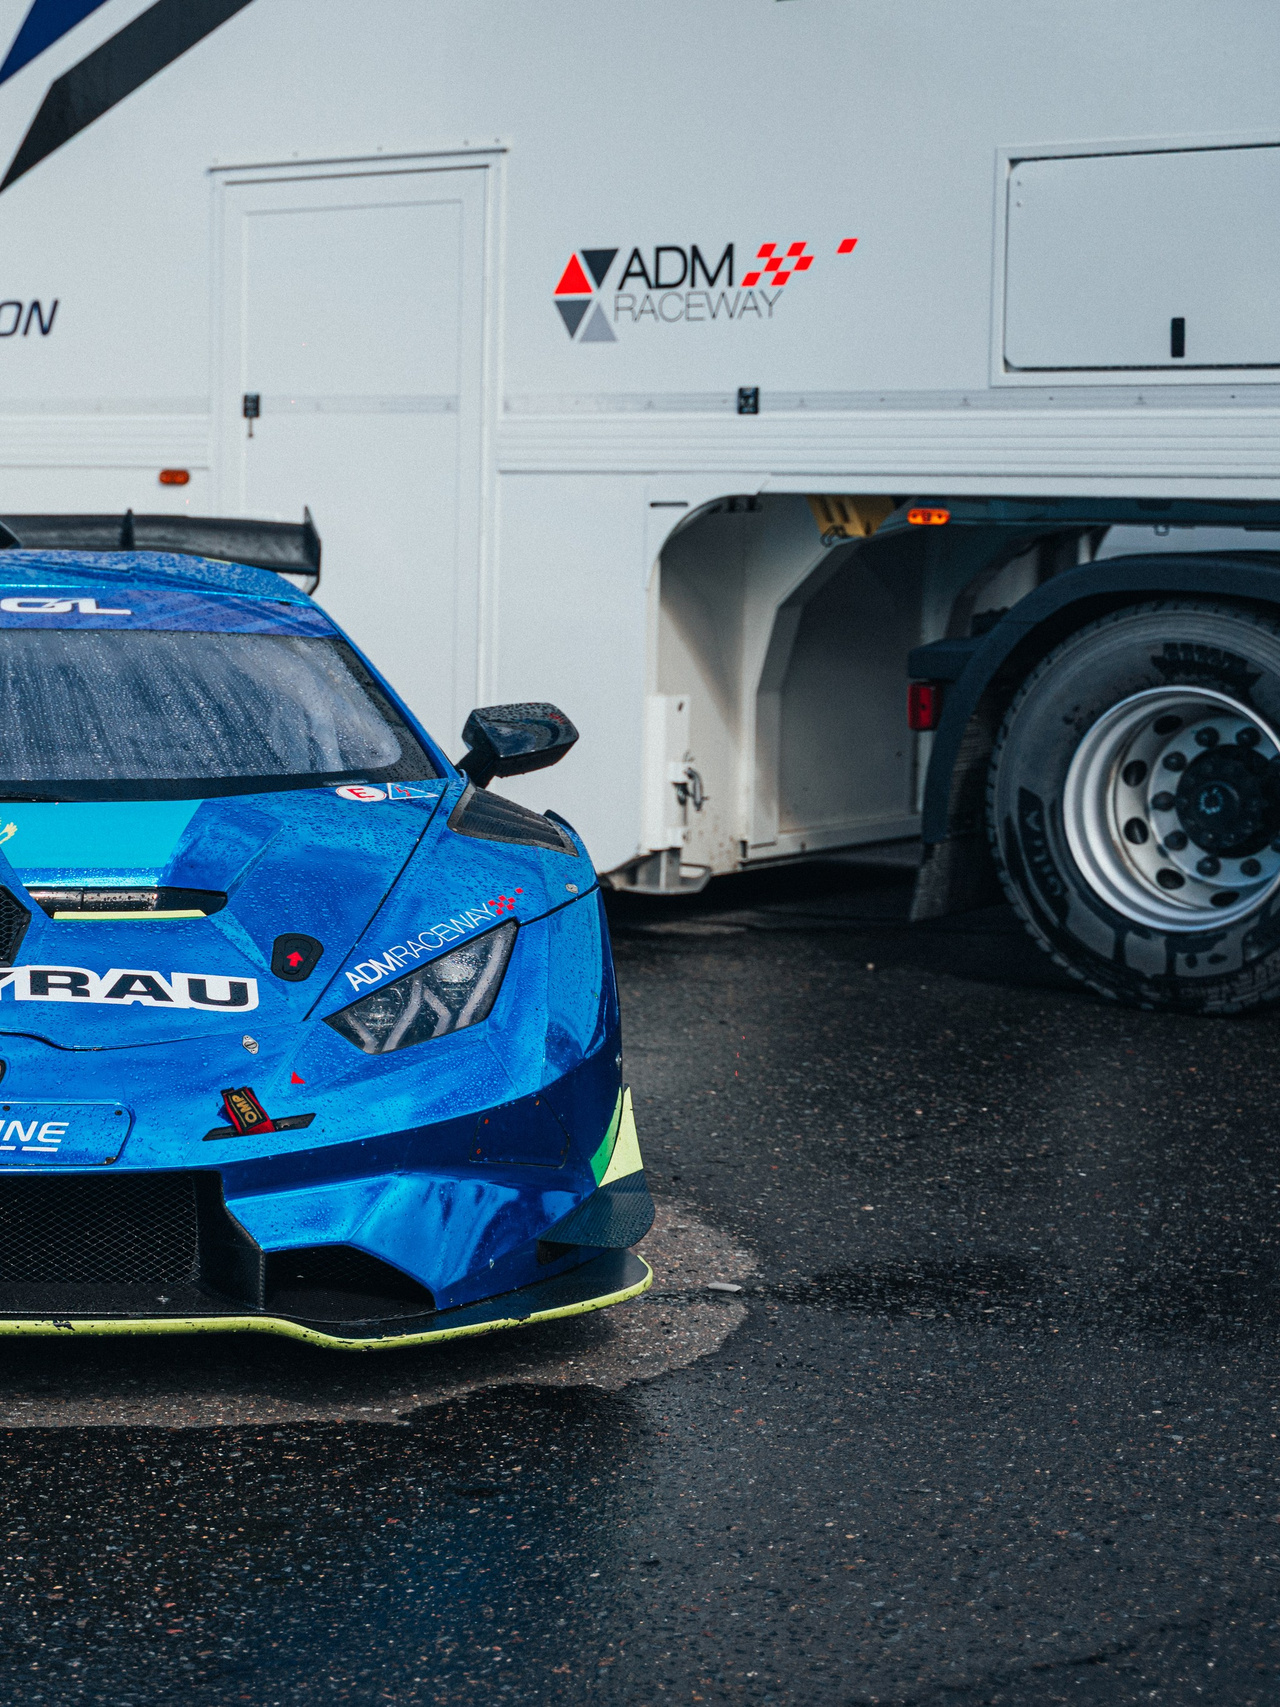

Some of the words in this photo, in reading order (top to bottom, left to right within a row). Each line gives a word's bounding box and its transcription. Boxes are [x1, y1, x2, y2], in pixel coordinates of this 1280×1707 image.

[617, 242, 734, 291] ADM
[613, 289, 784, 323] RACEWAY
[346, 787, 376, 799] E
[231, 1094, 258, 1124] OMP
